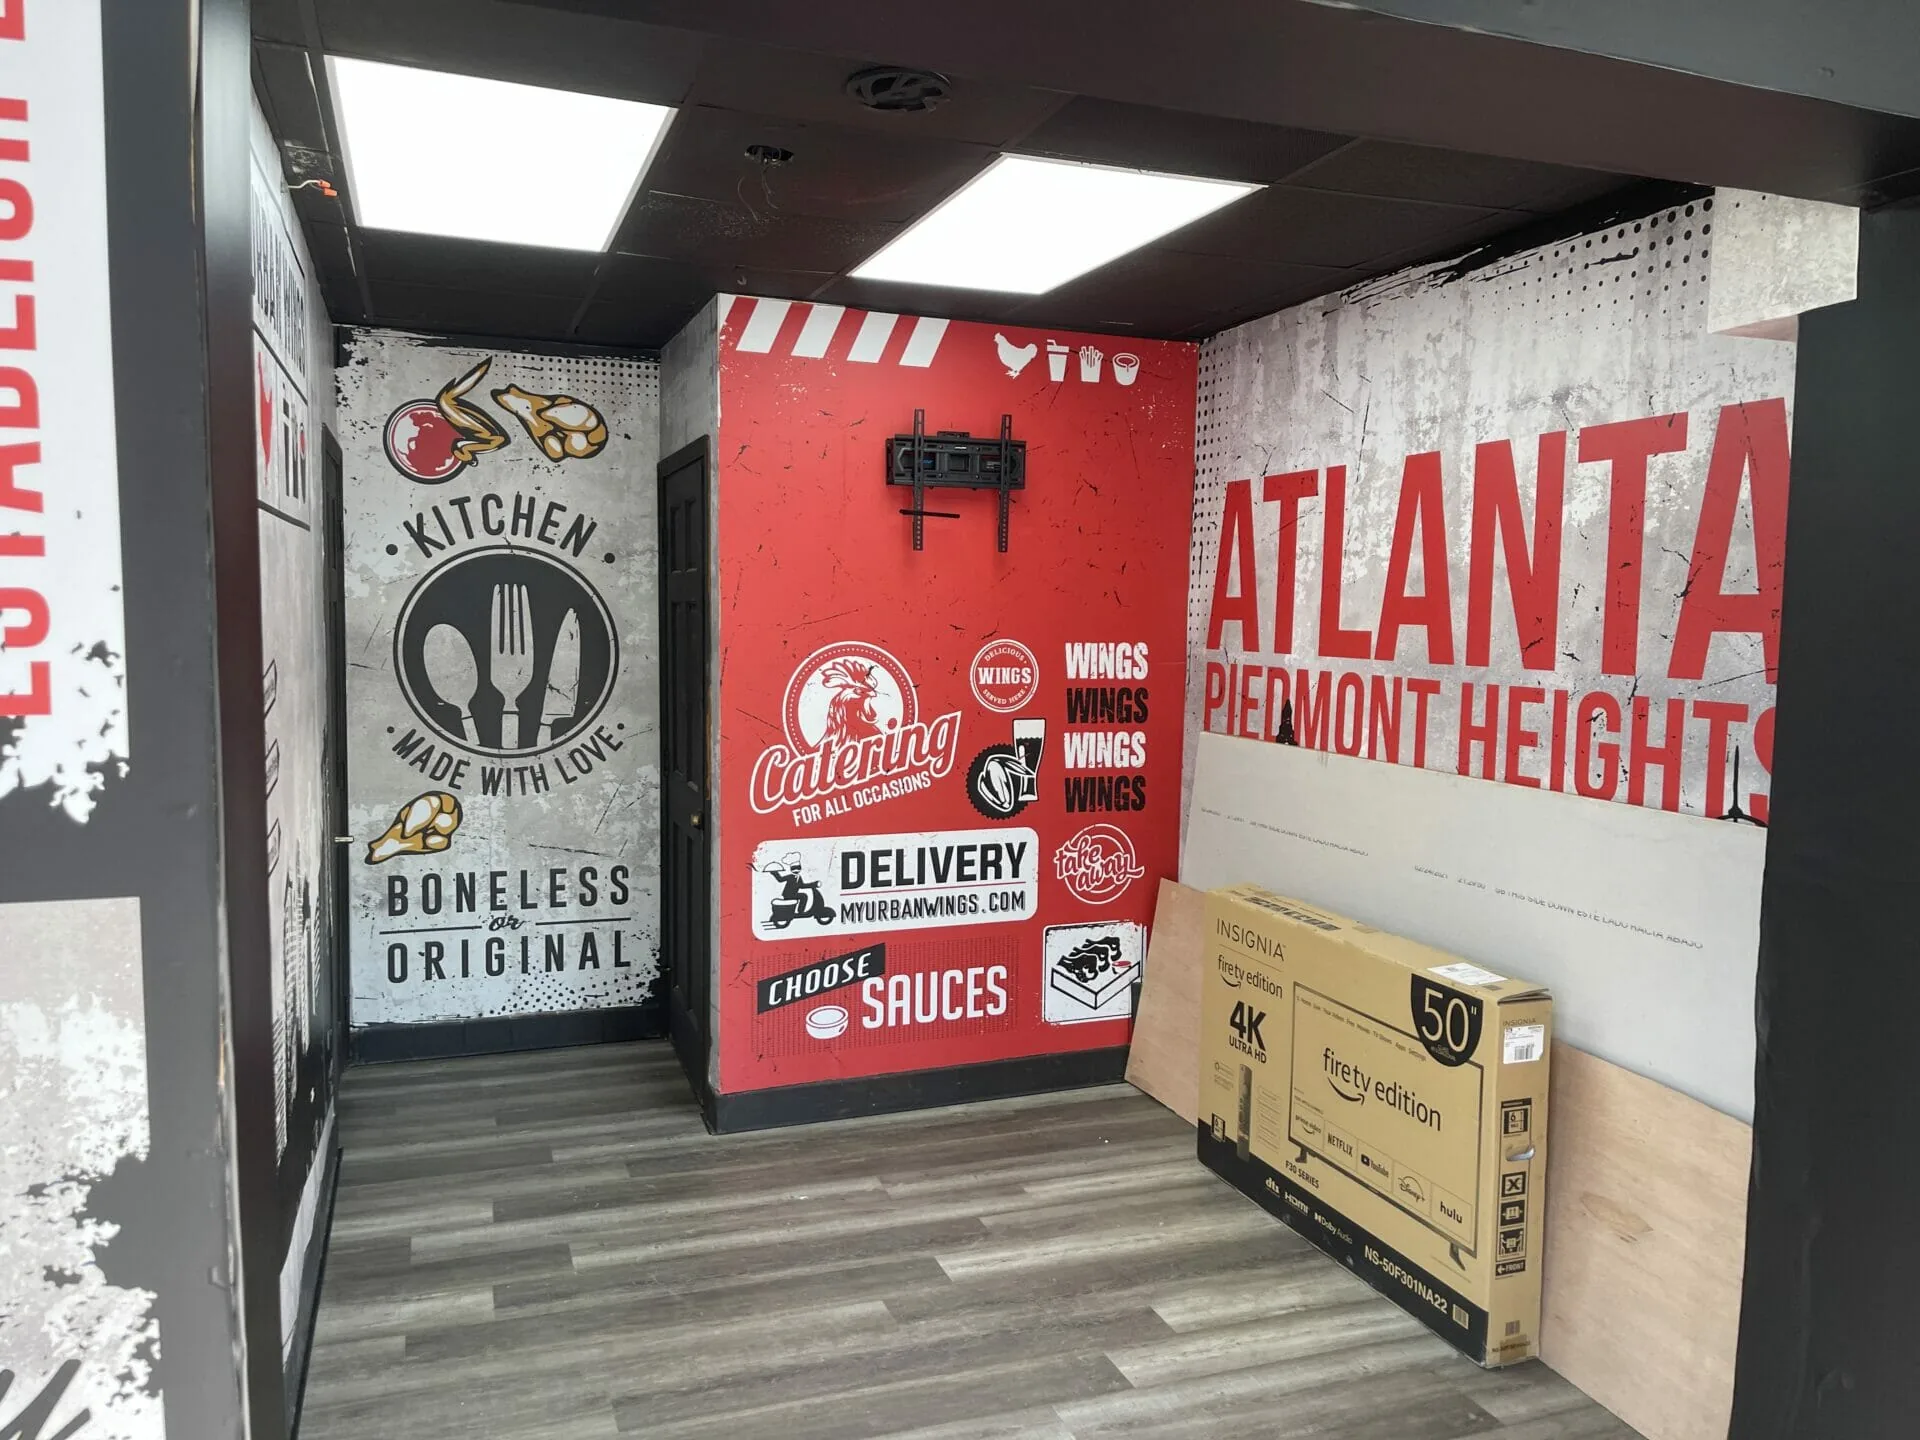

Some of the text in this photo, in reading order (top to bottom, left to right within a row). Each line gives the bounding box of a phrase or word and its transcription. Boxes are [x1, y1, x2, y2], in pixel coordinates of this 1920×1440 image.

[403, 492, 598, 558] KITCHEN
[1205, 397, 1791, 684] ATLANTA
[977, 667, 1032, 685] WINGS
[984, 647, 1025, 661] DELICIOUS
[1065, 642, 1149, 680] WINGS
[982, 688, 1026, 705] SERVED HERE
[1066, 687, 1150, 724] WINGS
[1203, 662, 1440, 769] PIEDMONT
[391, 725, 624, 797] MADE WITH LOVE
[749, 710, 962, 815] Catering
[1064, 731, 1147, 769] WINGS
[792, 770, 931, 827] FOR ALL OCCASIONS
[1065, 775, 1147, 813] WINGS
[840, 841, 1028, 890] DELIVERY
[1053, 835, 1102, 879] take
[1076, 852, 1145, 891] away
[387, 864, 631, 918] BONELESS
[488, 914, 526, 932] or
[1216, 917, 1284, 962] INSIGNIA
[387, 930, 632, 984] ORIGINAL
[768, 951, 873, 1006] CHOOSE
[862, 965, 1008, 1029] SAUCES
[1246, 971, 1283, 999] edition
[1229, 1000, 1267, 1052] 4K
[1228, 1034, 1267, 1064] ULTRA HD
[1375, 1081, 1441, 1132] edition
[1327, 1133, 1353, 1157] NETFLIX
[1285, 1160, 1320, 1190] F30 SERIES
[1320, 1217, 1337, 1236] Dolby
[1440, 1201, 1463, 1224] hulu
[1364, 1244, 1448, 1314] NS-50F301NA22
